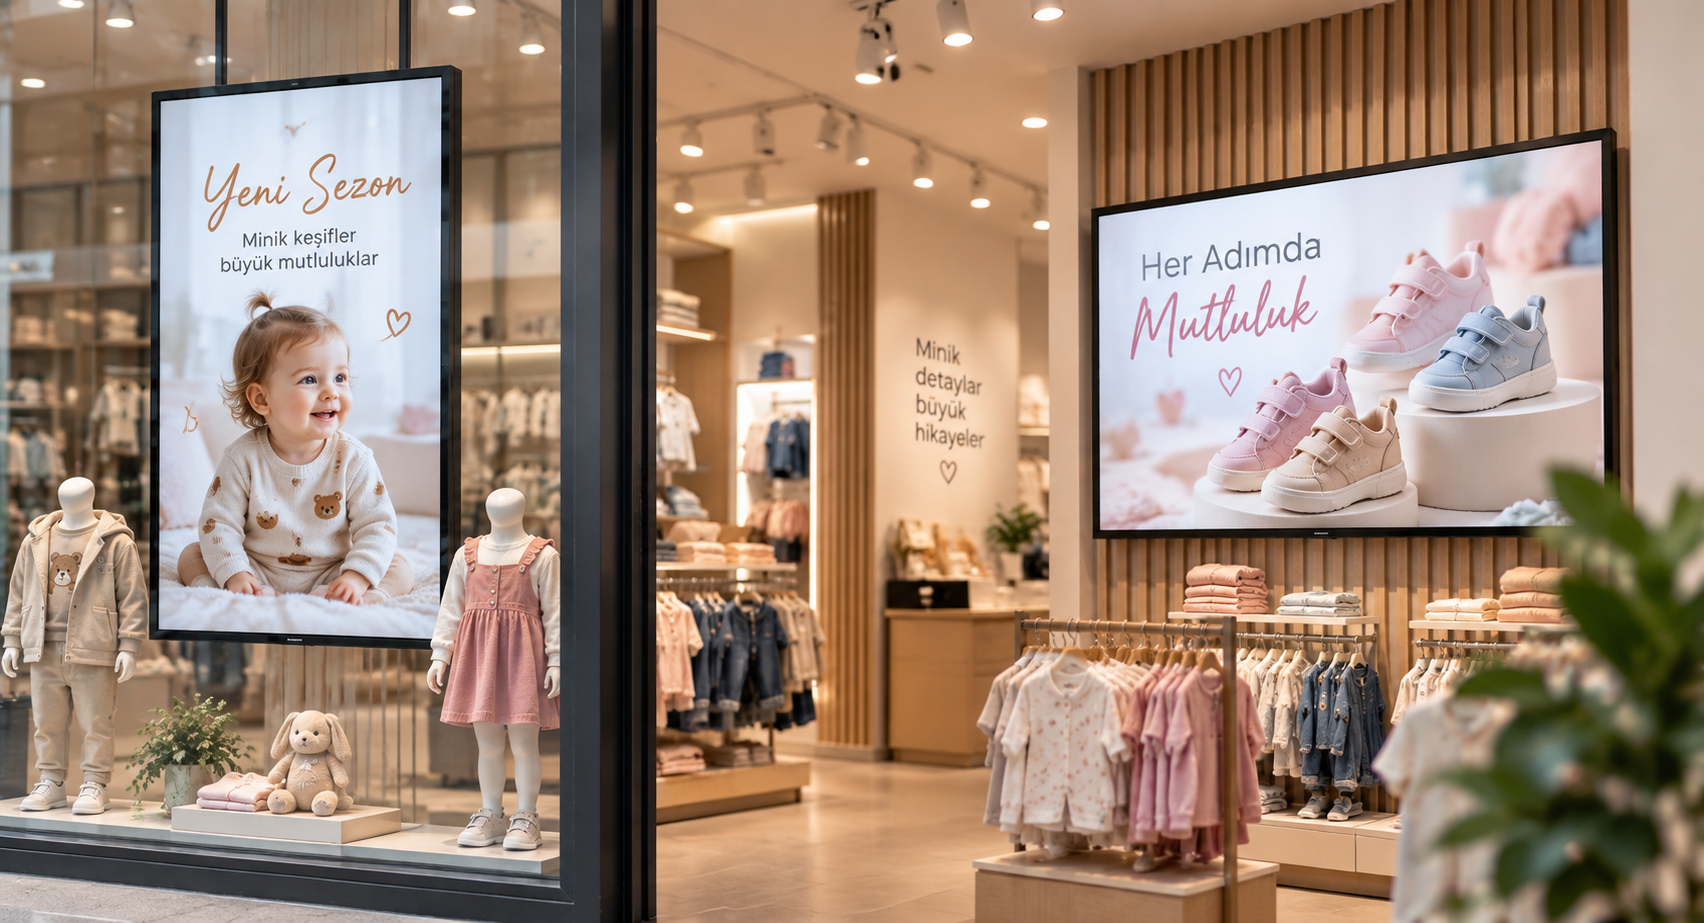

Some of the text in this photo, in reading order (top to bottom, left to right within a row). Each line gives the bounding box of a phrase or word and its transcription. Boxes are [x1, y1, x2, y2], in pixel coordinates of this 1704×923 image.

[204, 153, 412, 232] Yeni Sezon
[242, 228, 357, 248] Minik keşifler
[220, 250, 379, 275] büyük mutluluklar
[1142, 232, 1321, 281] Her Adımda
[1130, 274, 1318, 360] Mutluluk
[916, 337, 961, 365] Minik
[915, 366, 982, 397] detaylar
[916, 393, 966, 422] büyük
[915, 421, 985, 450] hikayeler
